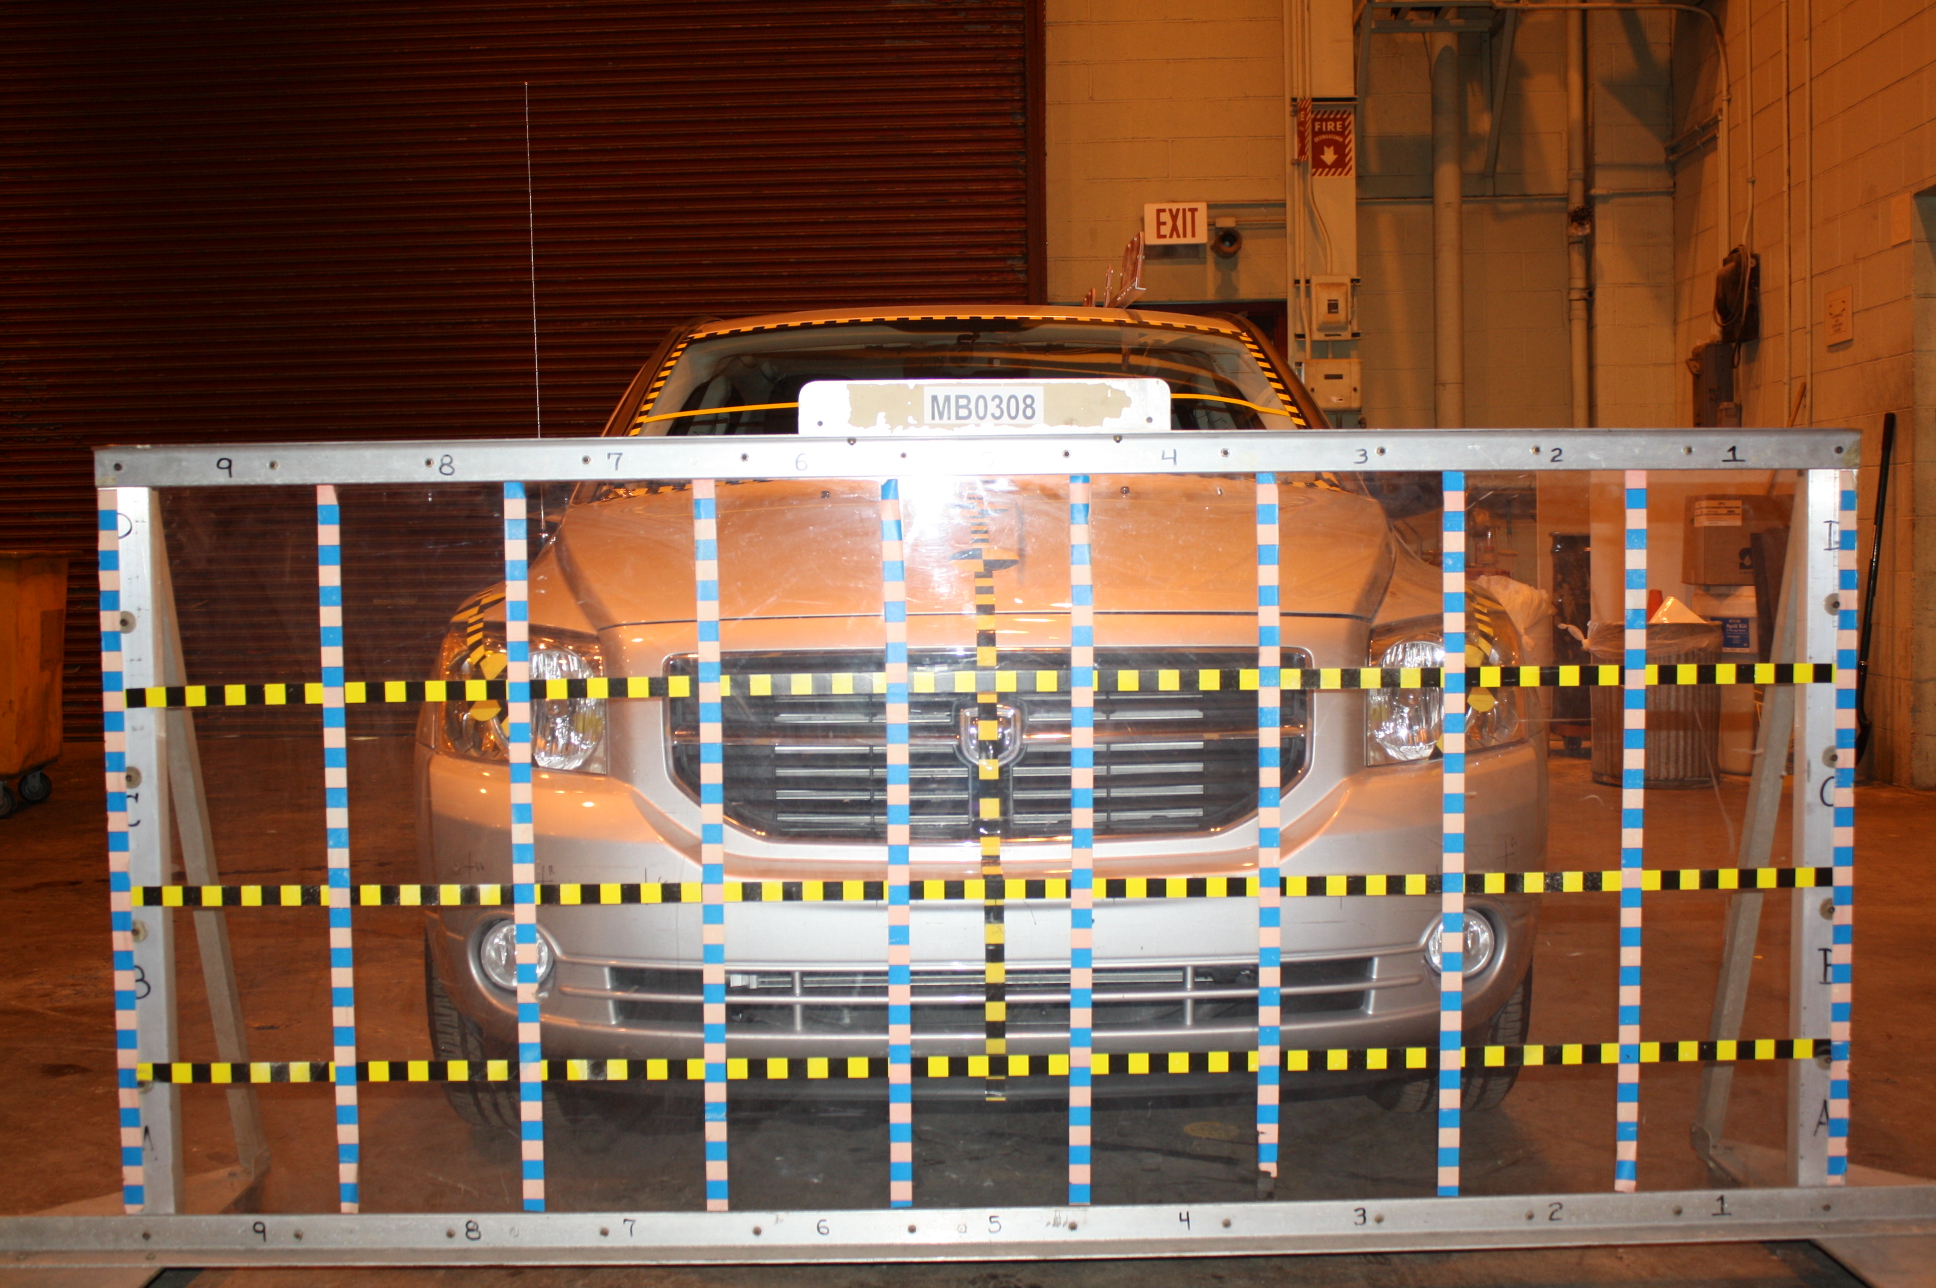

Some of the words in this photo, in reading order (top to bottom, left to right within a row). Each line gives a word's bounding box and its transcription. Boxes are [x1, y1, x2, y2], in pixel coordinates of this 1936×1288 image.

[1314, 121, 1343, 132] FIRE
[1156, 208, 1199, 239] EXIT
[930, 394, 1036, 421] MB0308
[216, 458, 232, 478] 9
[439, 454, 455, 476] 8
[607, 452, 623, 471] 7
[795, 453, 808, 471] 6
[1161, 449, 1177, 466] 4
[1353, 449, 1368, 464] 3
[1550, 447, 1563, 463] 2
[1721, 445, 1746, 463] 1
[253, 1221, 266, 1242] 9
[465, 1220, 481, 1240] 8
[623, 1218, 637, 1238] 7
[816, 1219, 830, 1236] 6
[987, 1215, 1001, 1233] 5
[1179, 1211, 1190, 1231] 4
[1353, 1207, 1366, 1226] 3
[1548, 1202, 1563, 1221] 2
[1711, 1194, 1732, 1216] 1
